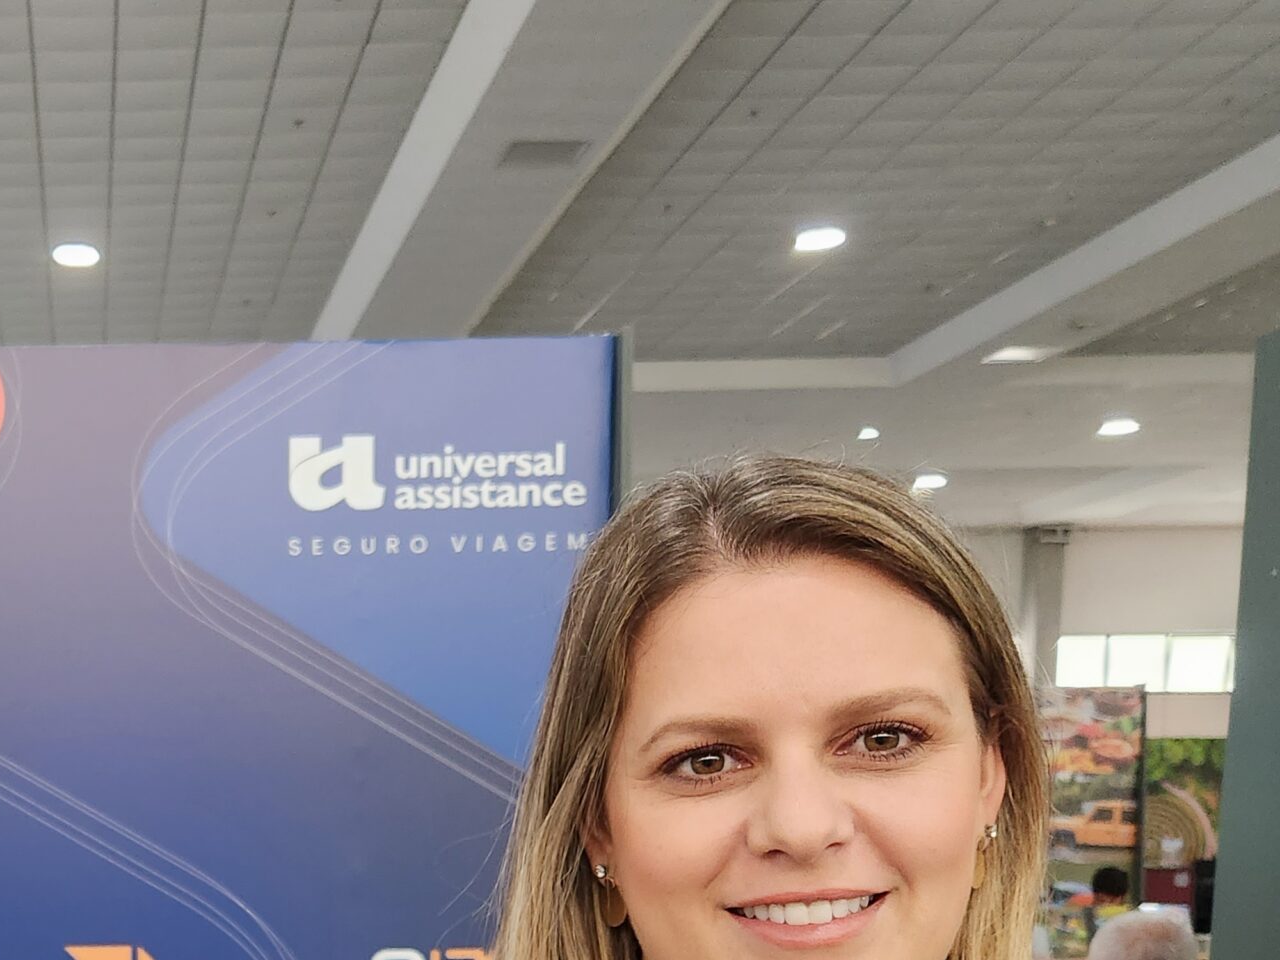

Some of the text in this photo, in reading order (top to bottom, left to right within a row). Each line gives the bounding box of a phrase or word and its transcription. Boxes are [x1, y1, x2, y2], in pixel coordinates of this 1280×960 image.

[394, 441, 567, 479] universal
[394, 477, 587, 510] assistance
[287, 533, 588, 557] SEGURO VIAGEM
